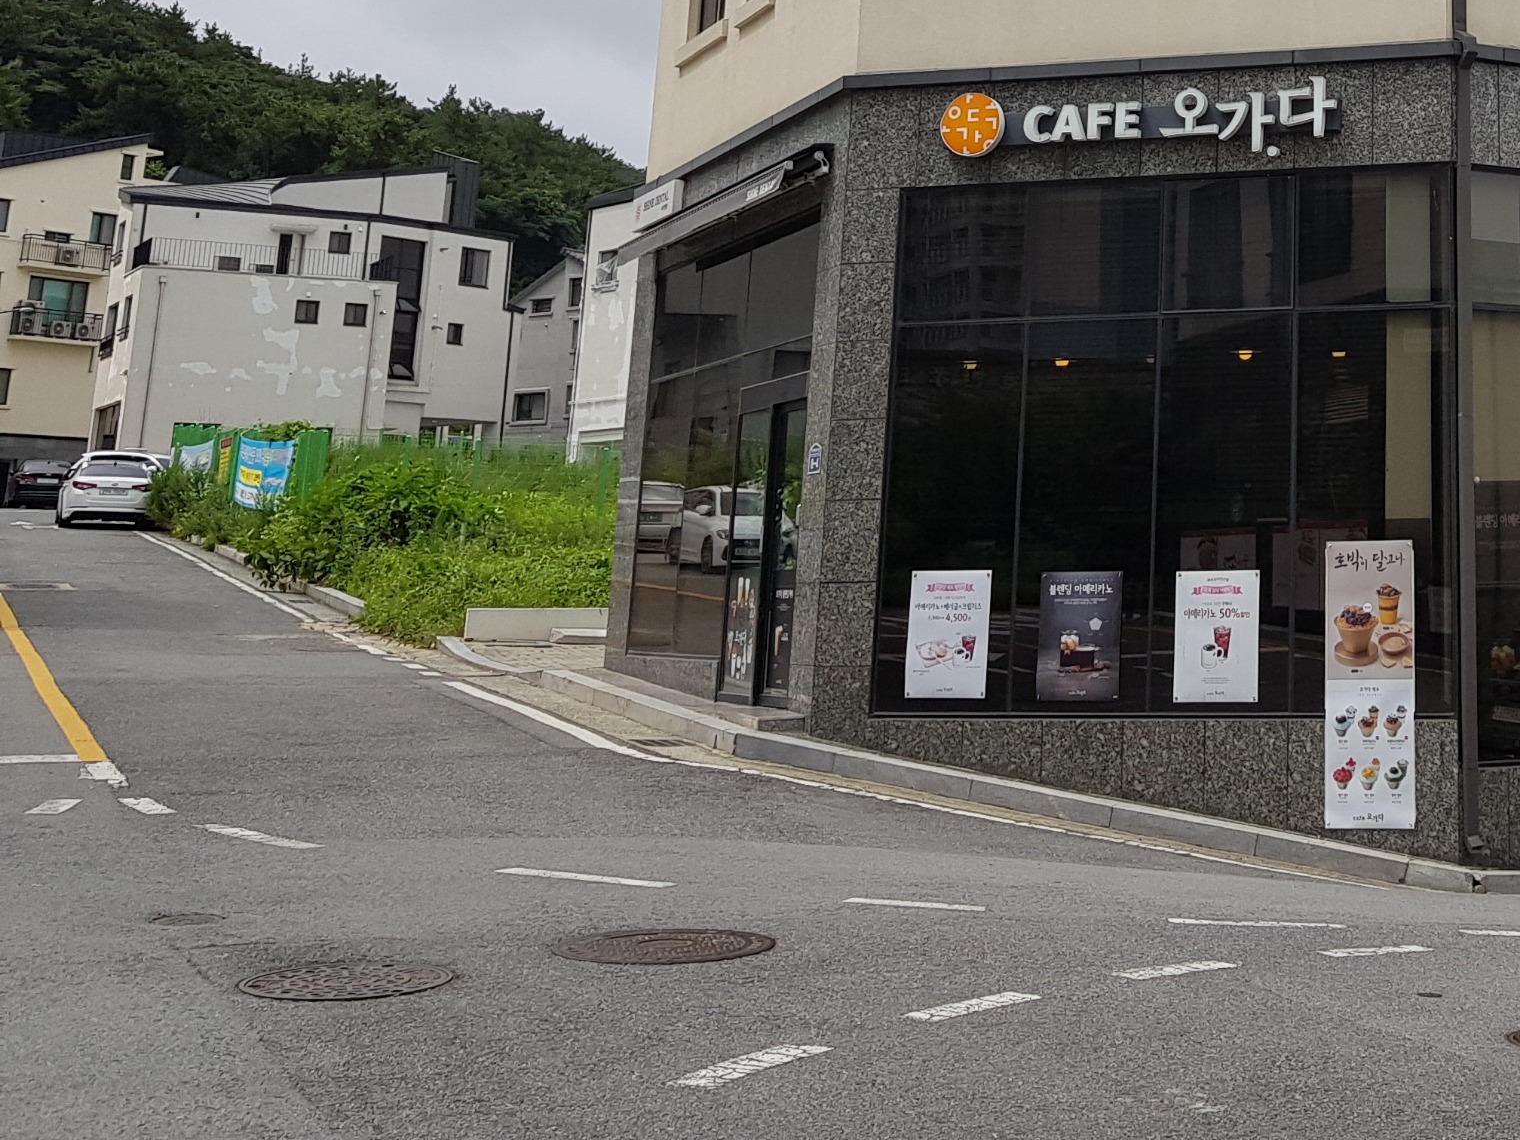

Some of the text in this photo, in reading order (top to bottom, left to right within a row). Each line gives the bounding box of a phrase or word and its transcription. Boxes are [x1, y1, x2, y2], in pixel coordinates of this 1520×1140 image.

[1023, 100, 1142, 143] CAFE
[1158, 75, 1338, 157] 오가다
[1049, 583, 1114, 596] 블렌딩 아메리카노
[1183, 608, 1217, 619] 아메리카노
